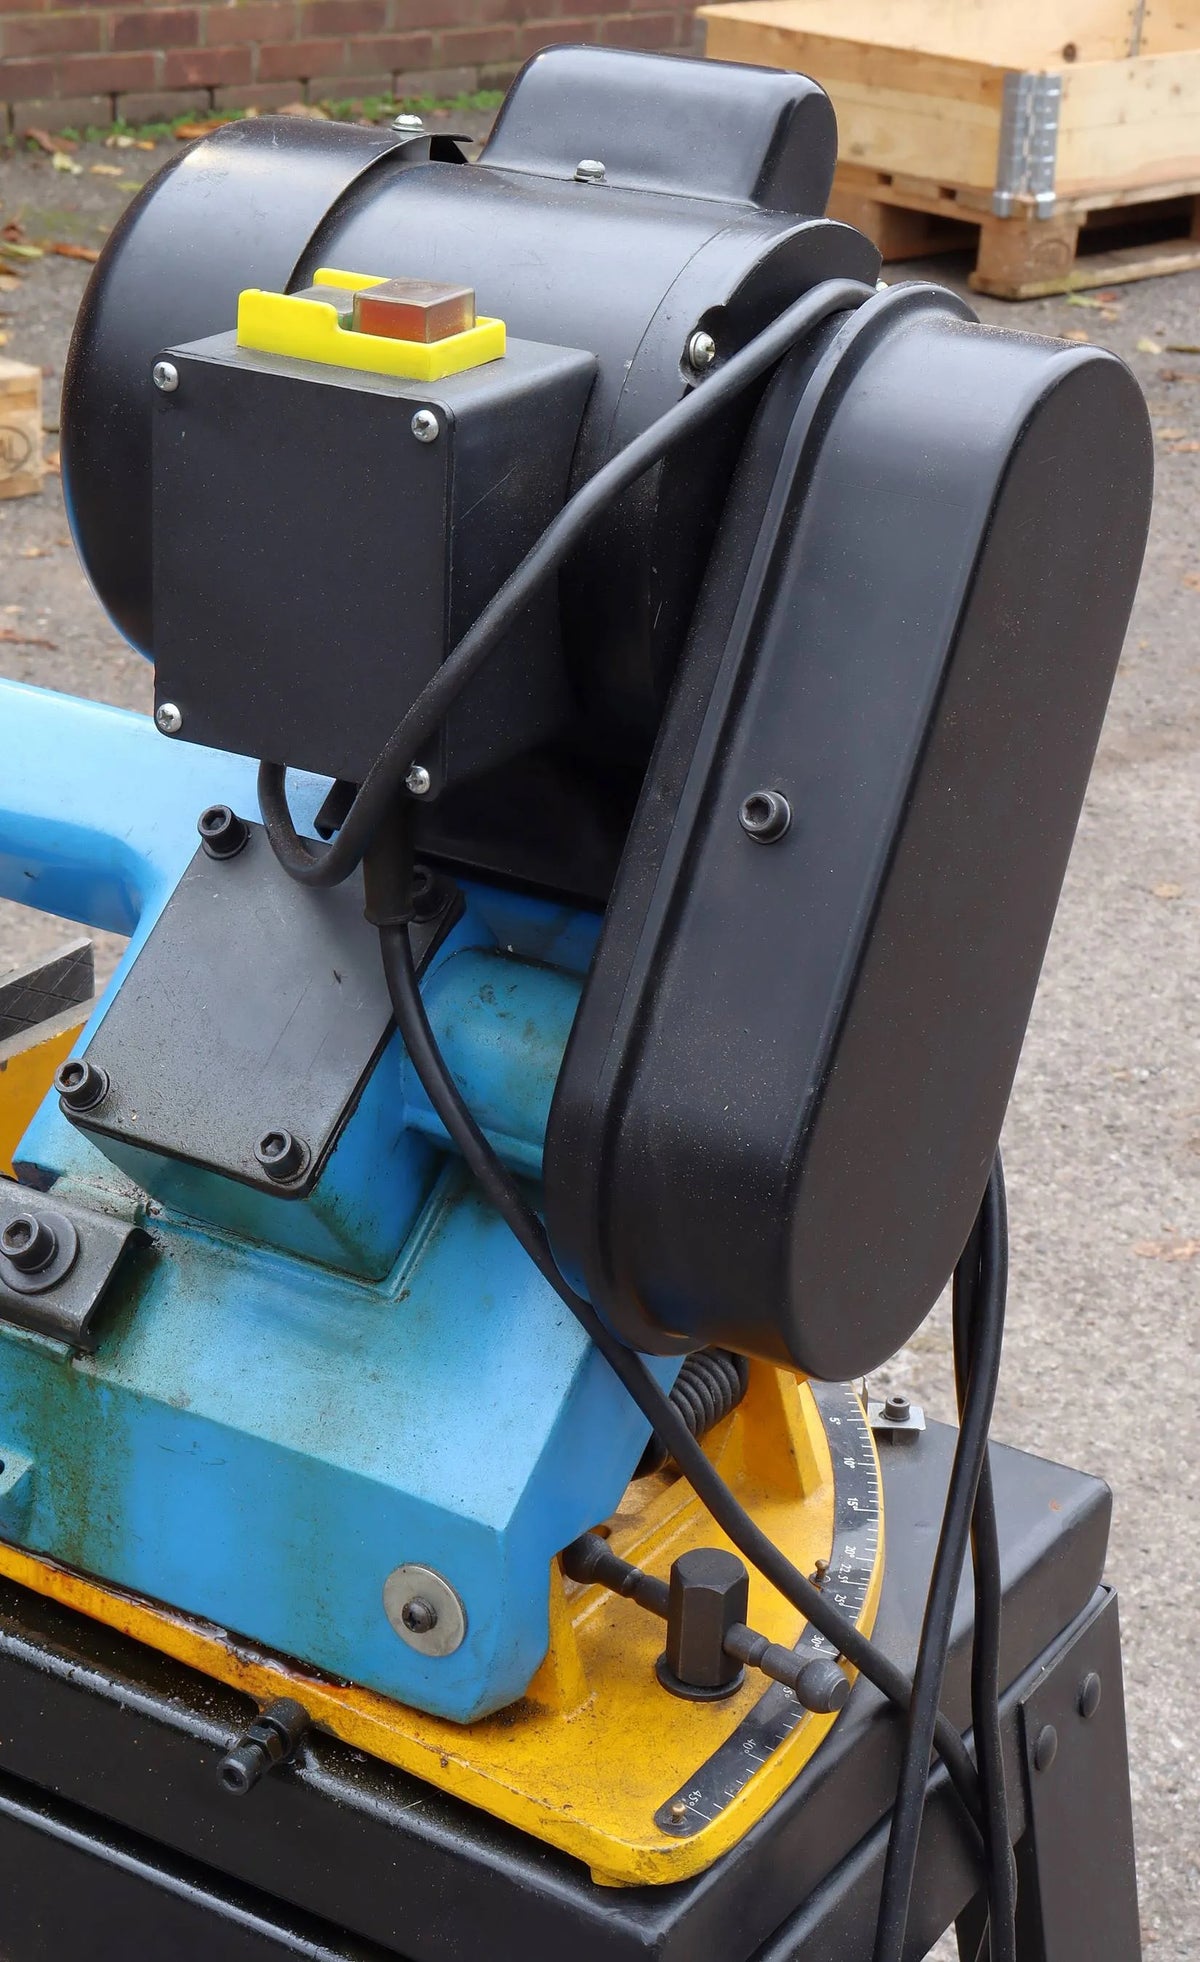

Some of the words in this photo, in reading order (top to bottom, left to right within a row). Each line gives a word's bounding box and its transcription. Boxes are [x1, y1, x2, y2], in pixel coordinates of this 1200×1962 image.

[843, 1457, 856, 1469] 10°
[846, 1497, 859, 1509] 15°
[844, 1545, 857, 1558] 20°
[834, 1593, 847, 1606] 25°
[810, 1634, 825, 1648] 30°
[743, 1738, 757, 1754] 40°
[688, 1790, 702, 1807] 45°
